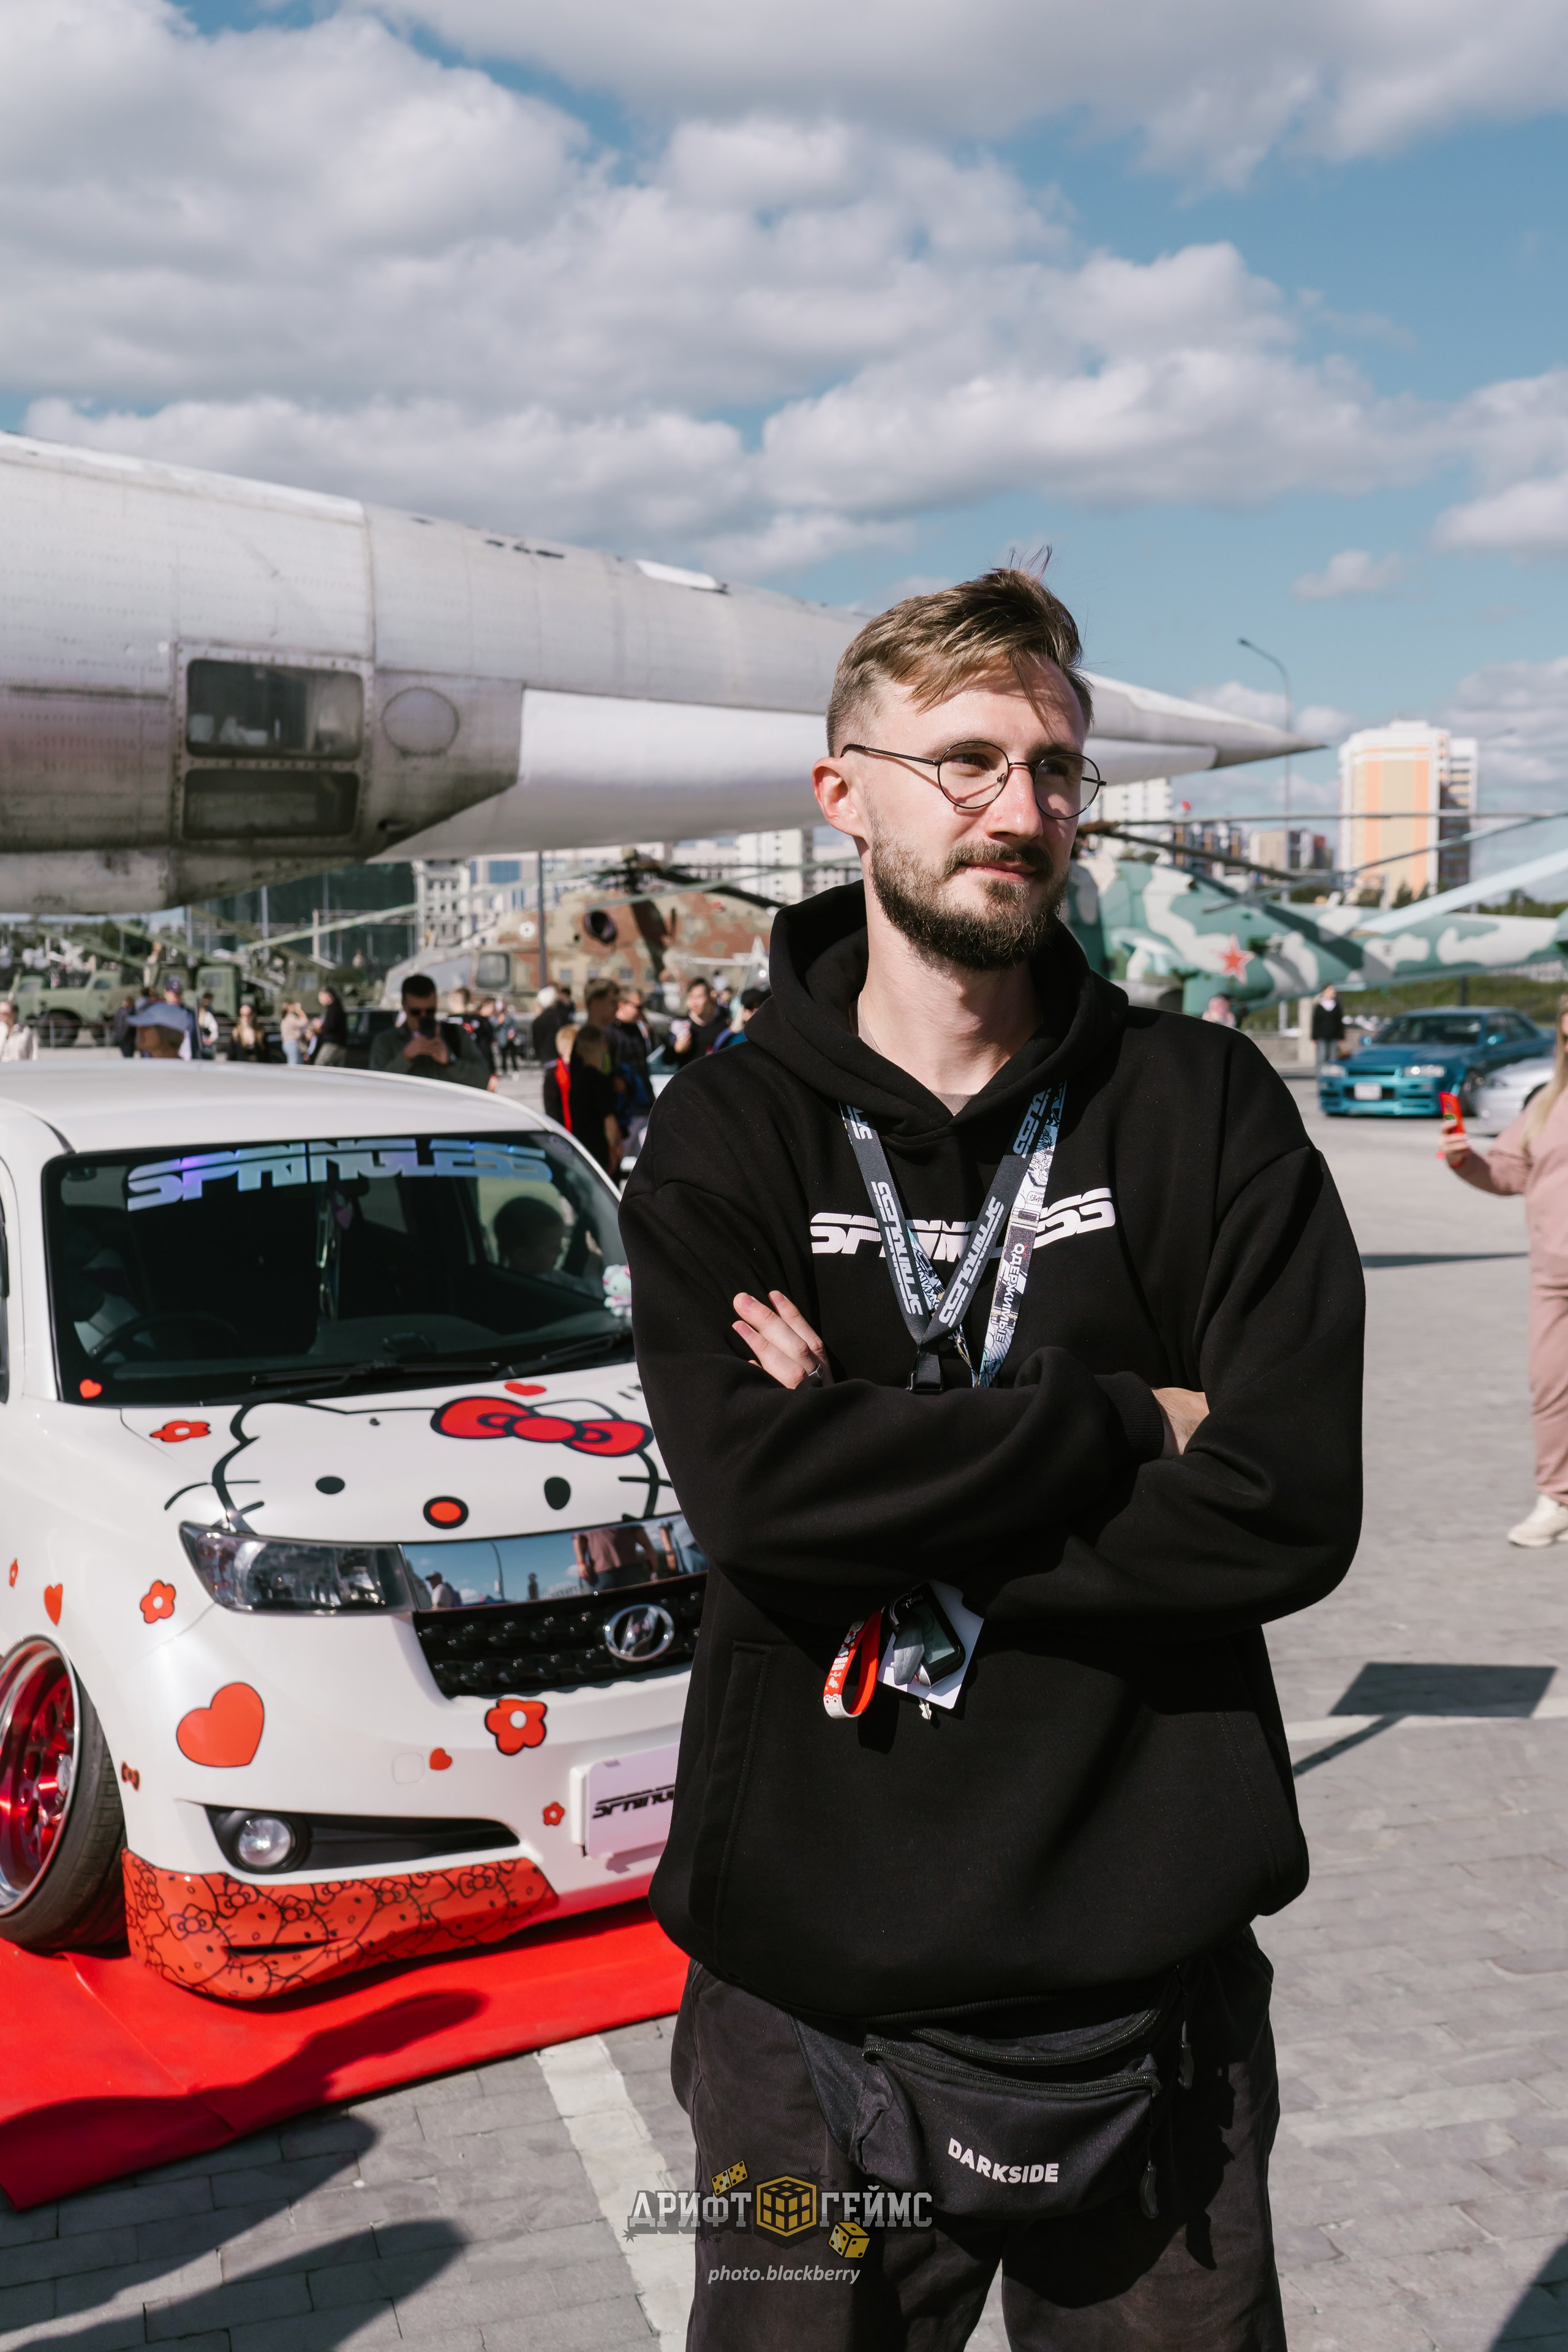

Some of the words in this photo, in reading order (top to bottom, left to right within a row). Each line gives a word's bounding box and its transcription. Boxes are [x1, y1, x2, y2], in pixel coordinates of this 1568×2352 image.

[127, 1139, 552, 1212] SPRINGLESS
[871, 1182, 923, 1315] SPRINGLESS
[939, 1196, 1005, 1328] SPRINGLESS
[948, 2138, 1059, 2184] DARKSIDE
